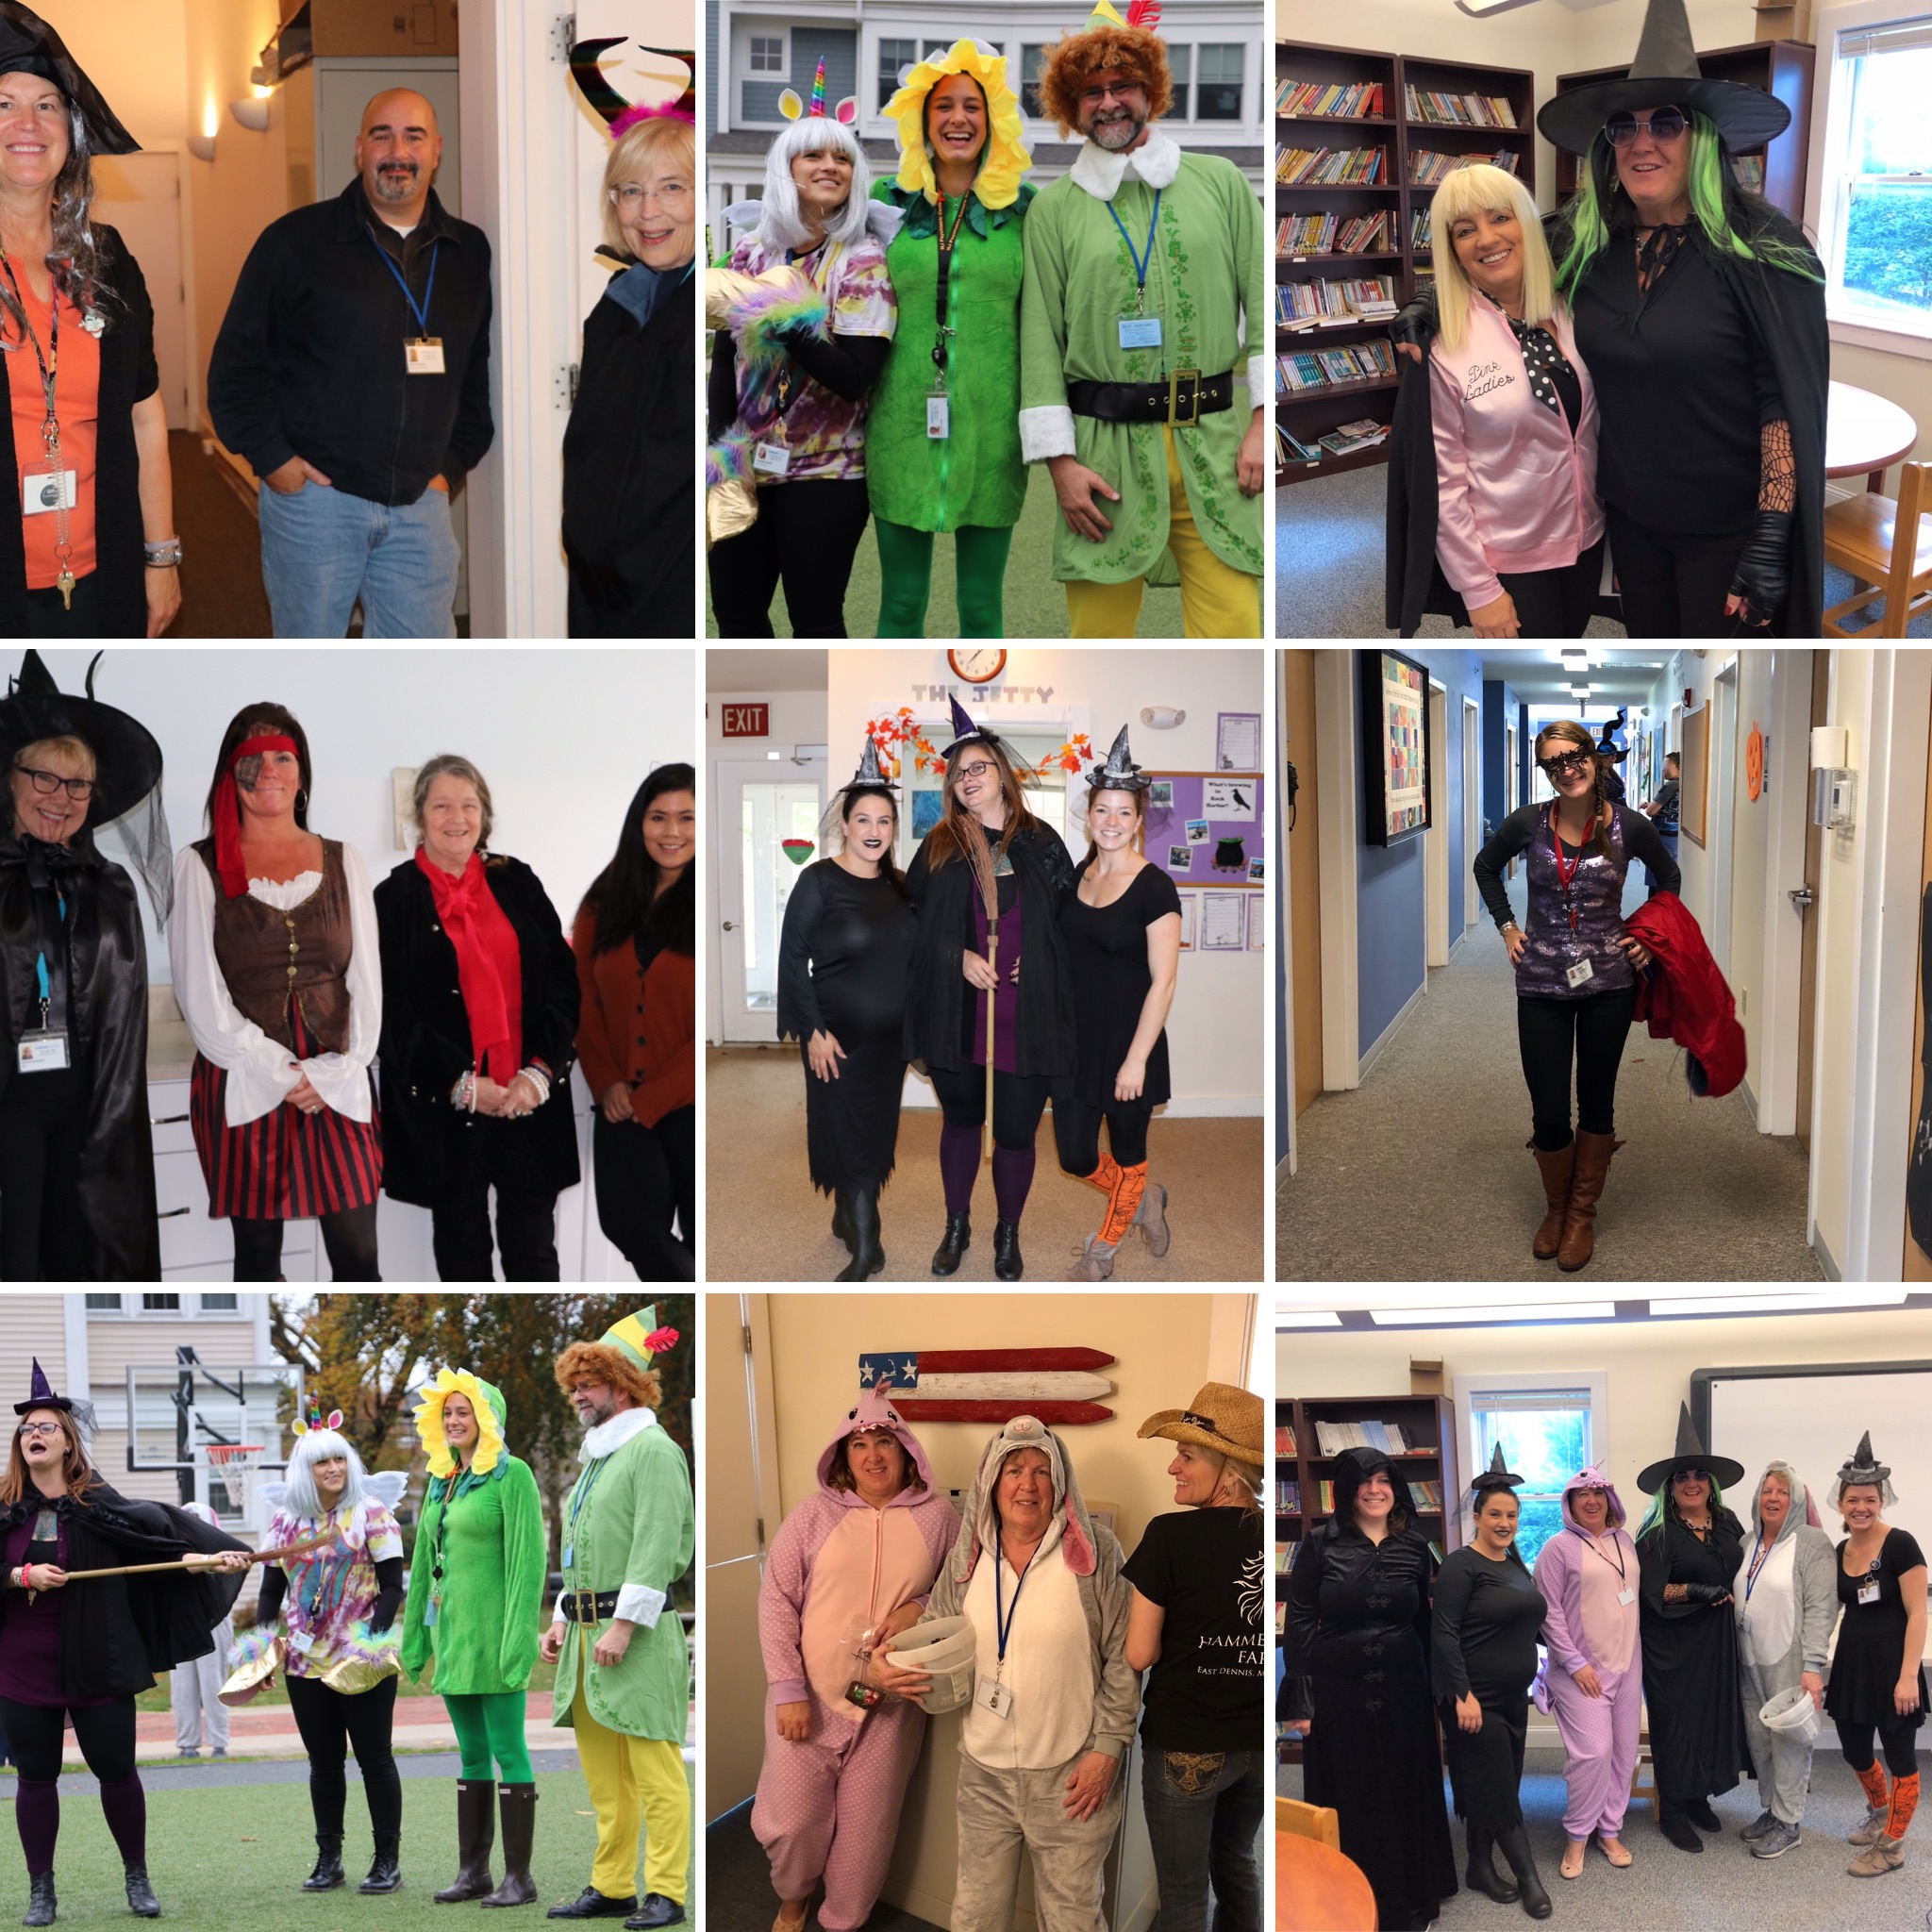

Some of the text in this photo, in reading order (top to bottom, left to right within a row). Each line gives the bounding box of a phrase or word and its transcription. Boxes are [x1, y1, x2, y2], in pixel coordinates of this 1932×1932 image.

[1469, 360, 1501, 383] Pink
[1464, 375, 1514, 403] Ladies
[973, 686, 1054, 704] JETTY
[724, 708, 762, 732] EXIT
[1197, 1666, 1218, 1675] EAST
